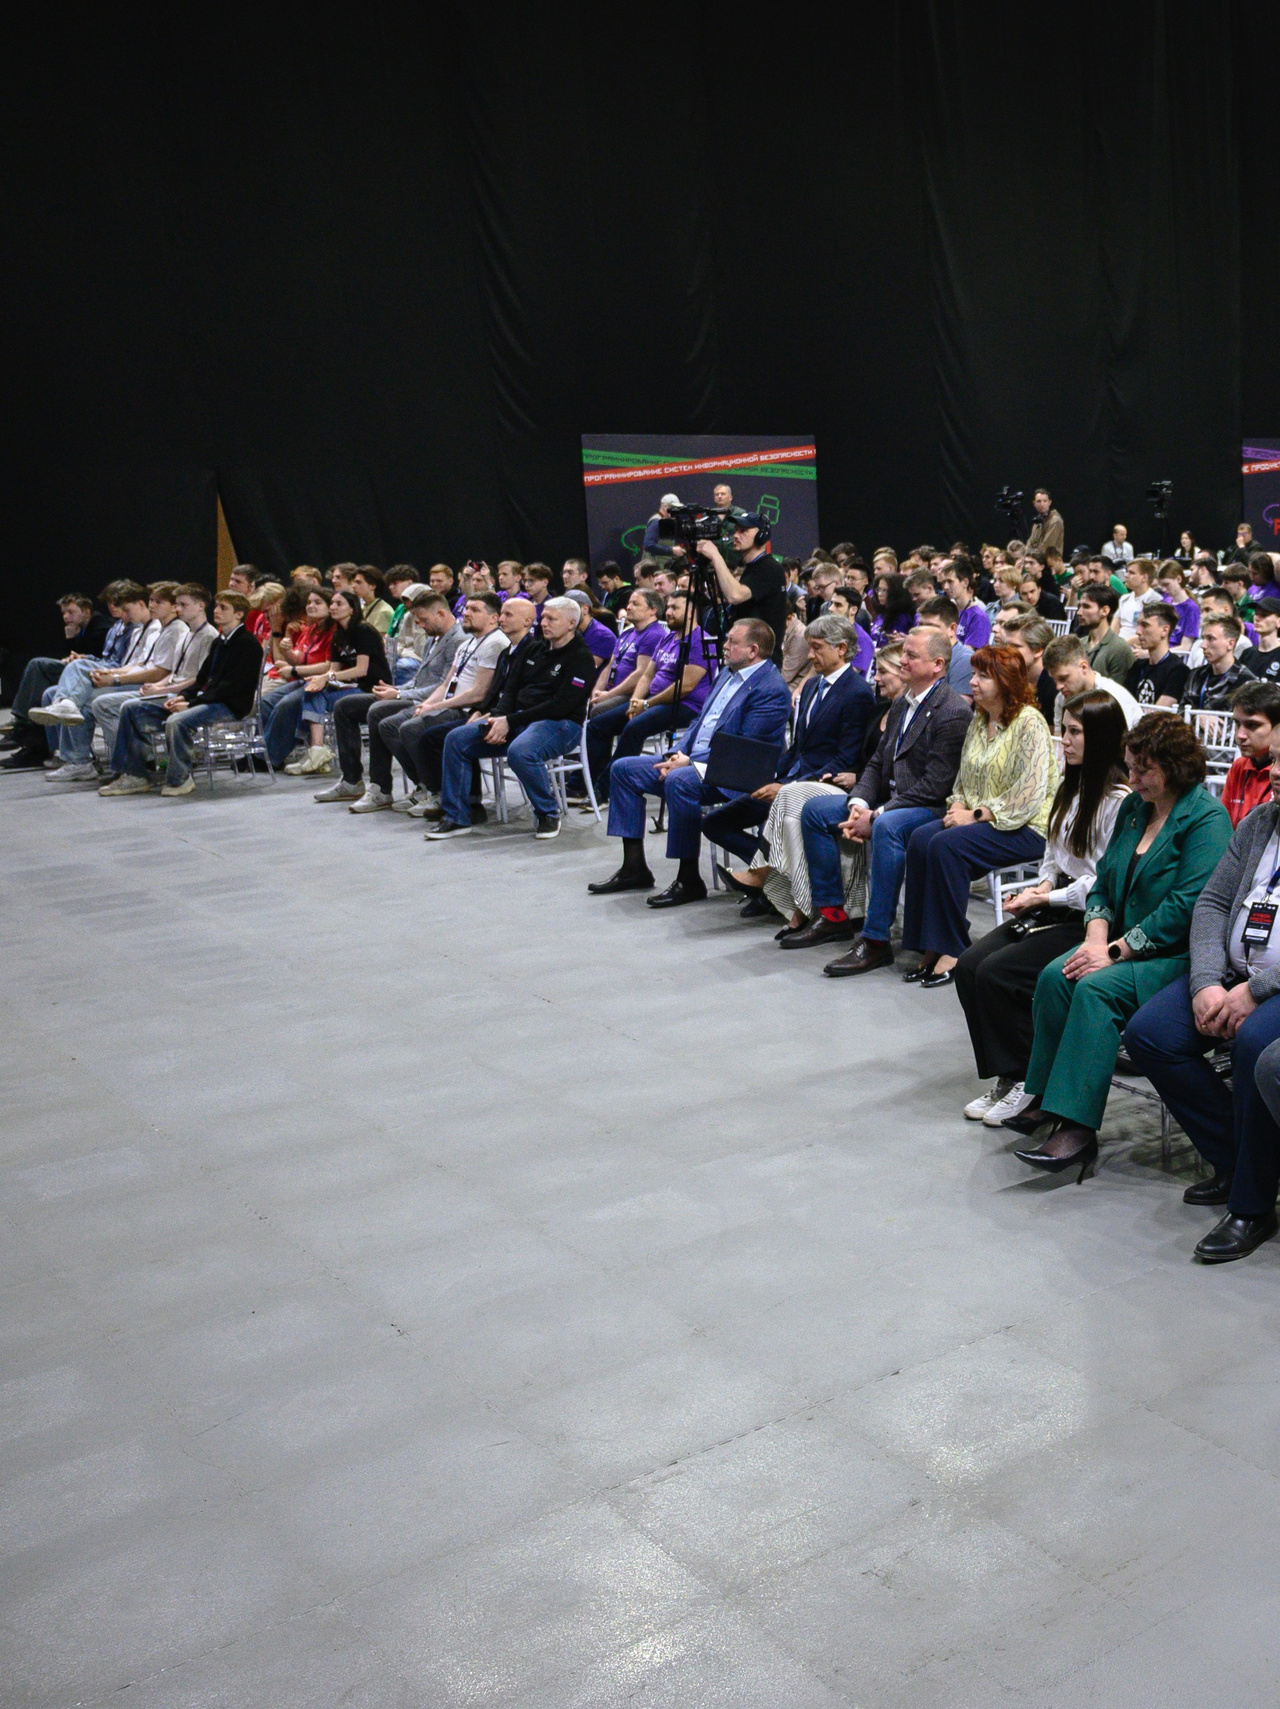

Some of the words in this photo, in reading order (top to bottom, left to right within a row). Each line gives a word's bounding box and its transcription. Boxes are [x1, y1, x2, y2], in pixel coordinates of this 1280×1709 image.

[584, 468, 662, 482] ПРОГРАММИРОВАНИЕ
[664, 465, 693, 474] СИСТЕМ
[694, 454, 759, 470] ИНФОРМАЦИОННОЙ
[760, 450, 813, 461] БЕЗОПАСНОСТИ
